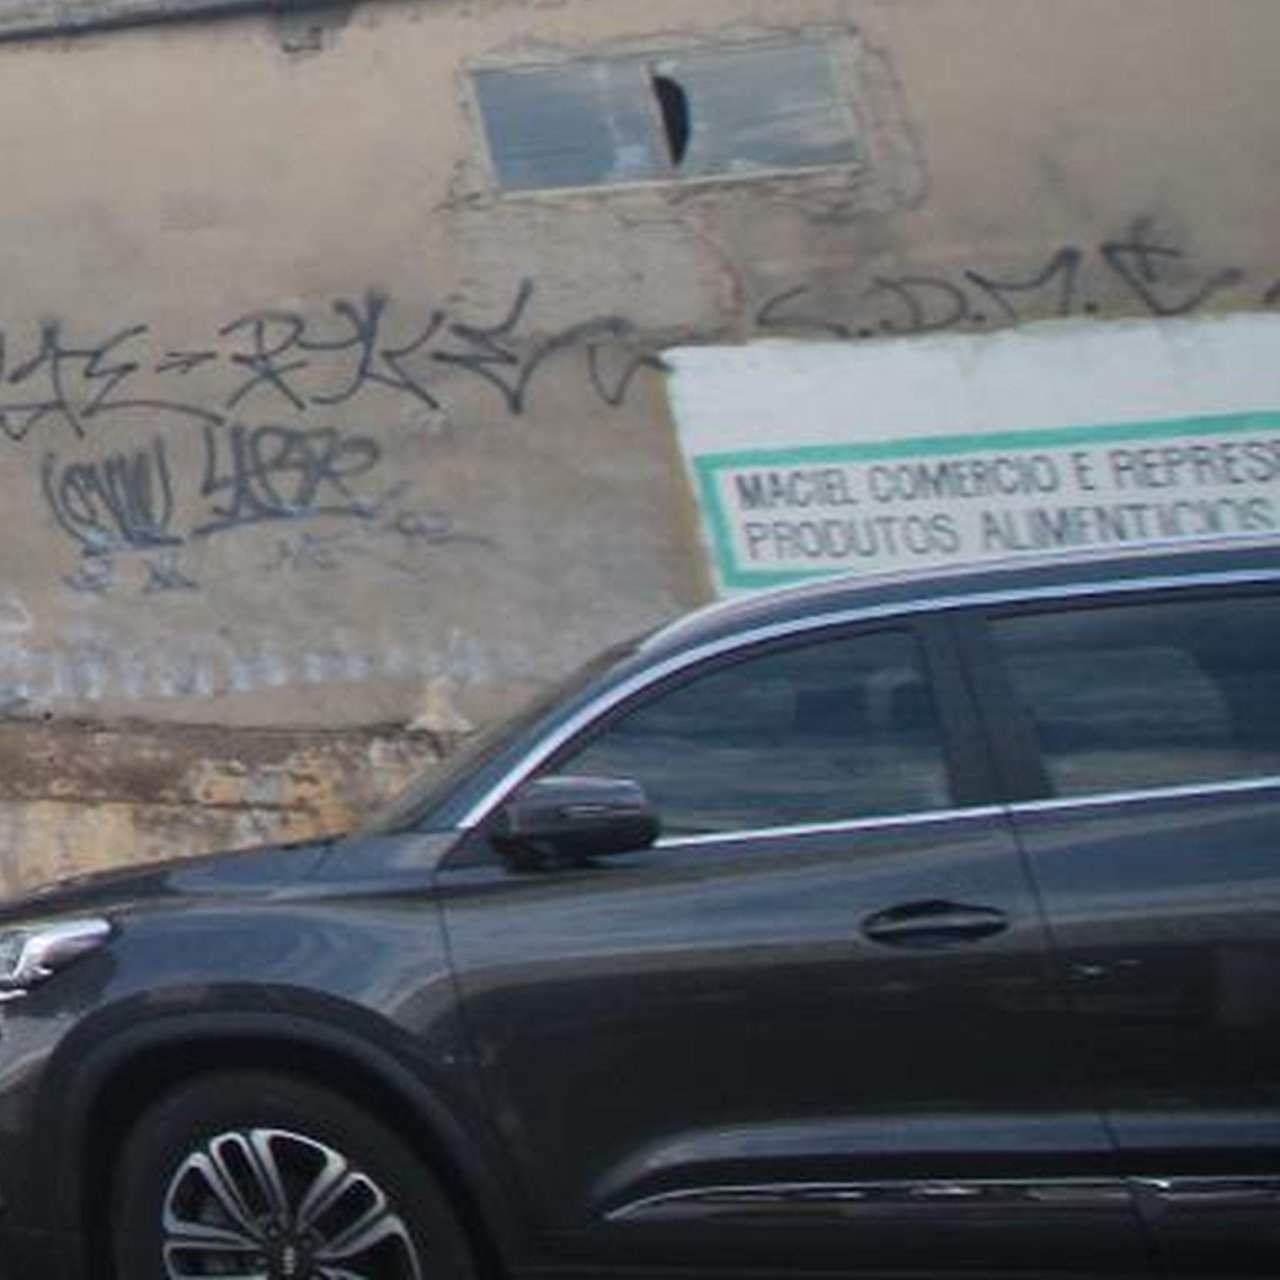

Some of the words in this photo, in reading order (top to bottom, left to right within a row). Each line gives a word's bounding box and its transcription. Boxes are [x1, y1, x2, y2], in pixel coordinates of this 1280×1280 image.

[735, 468, 859, 511] MACIEL
[869, 455, 1058, 503] COMERCIO
[1068, 451, 1096, 491] E
[744, 513, 961, 561] PRODUTOS
